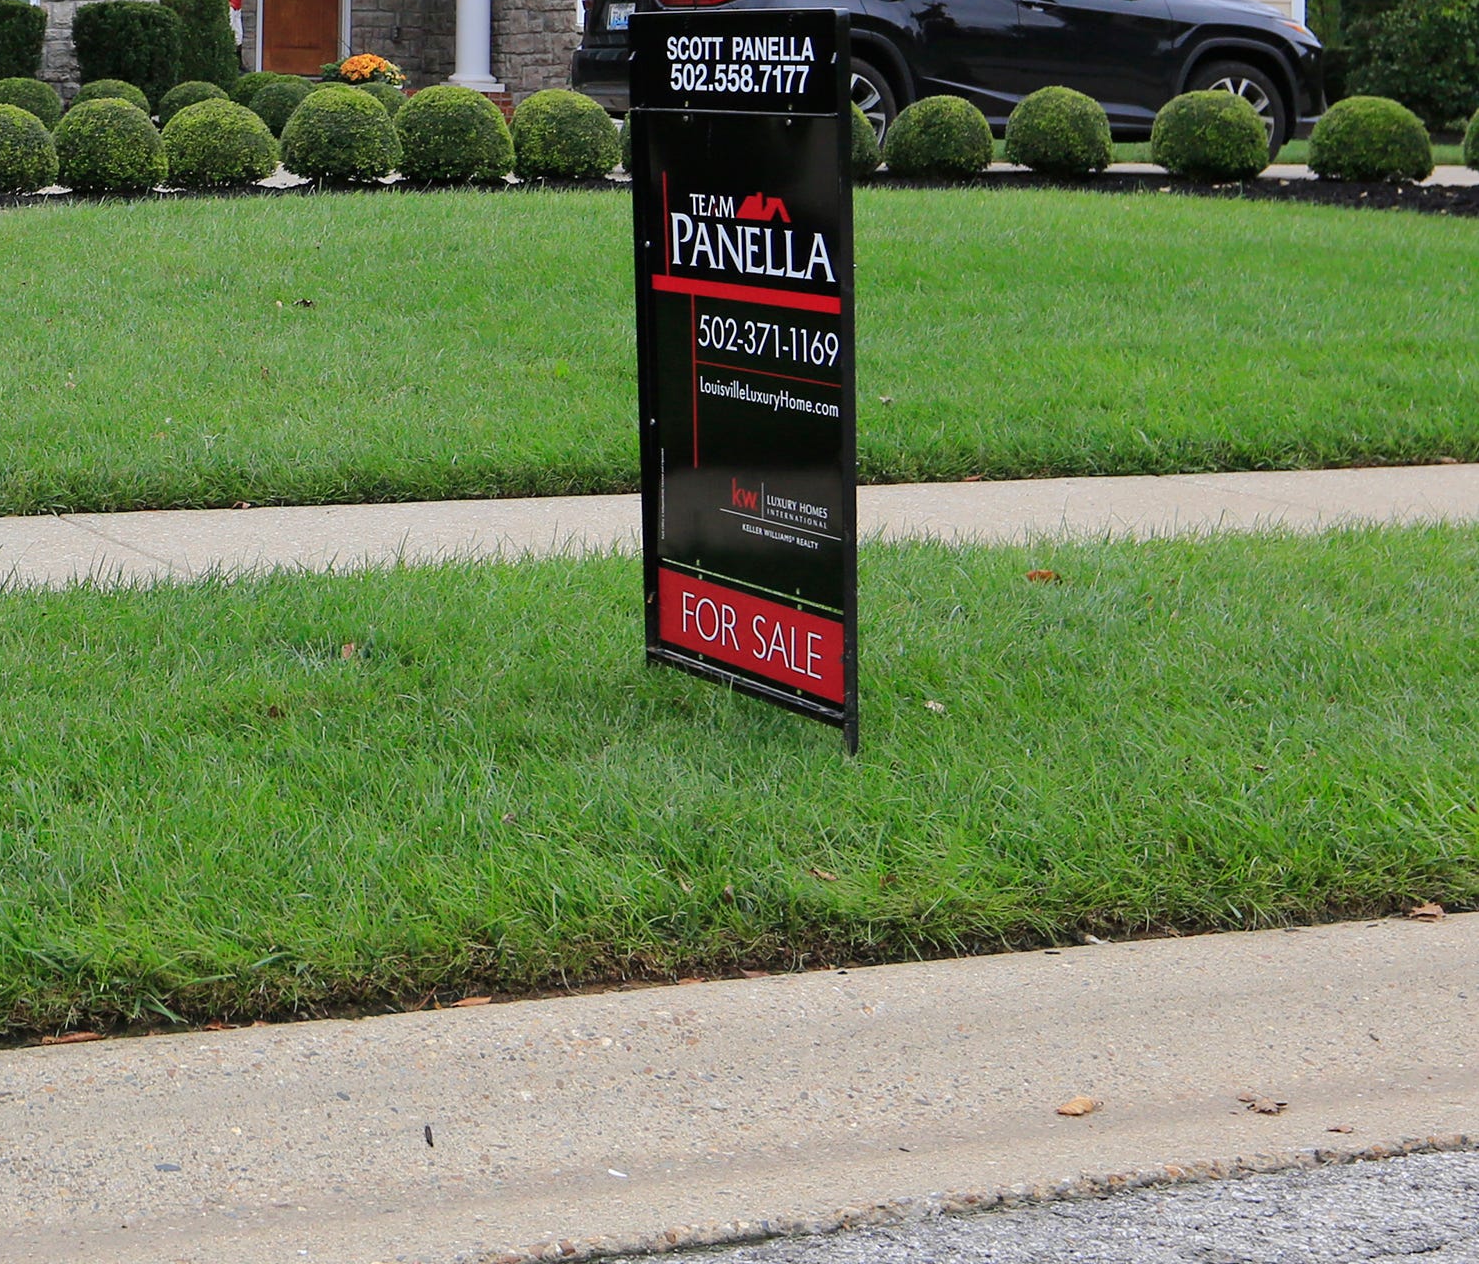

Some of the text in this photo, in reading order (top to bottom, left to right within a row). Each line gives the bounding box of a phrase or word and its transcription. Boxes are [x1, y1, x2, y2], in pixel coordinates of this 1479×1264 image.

[667, 36, 814, 61] SCOTT PANELLA
[670, 63, 809, 94] 502.558.7177
[689, 193, 735, 218] TEAM
[671, 212, 836, 282] PANELLA
[698, 314, 839, 367] 502-371-1169
[700, 376, 839, 418] LouisvilleLuxuryHome.com
[766, 495, 828, 519] LUXURY HOMES
[766, 508, 827, 529] INTERNATIONAL
[742, 523, 763, 536] KELLER
[796, 537, 819, 550] REALTY
[682, 591, 822, 679] FOR SALE
